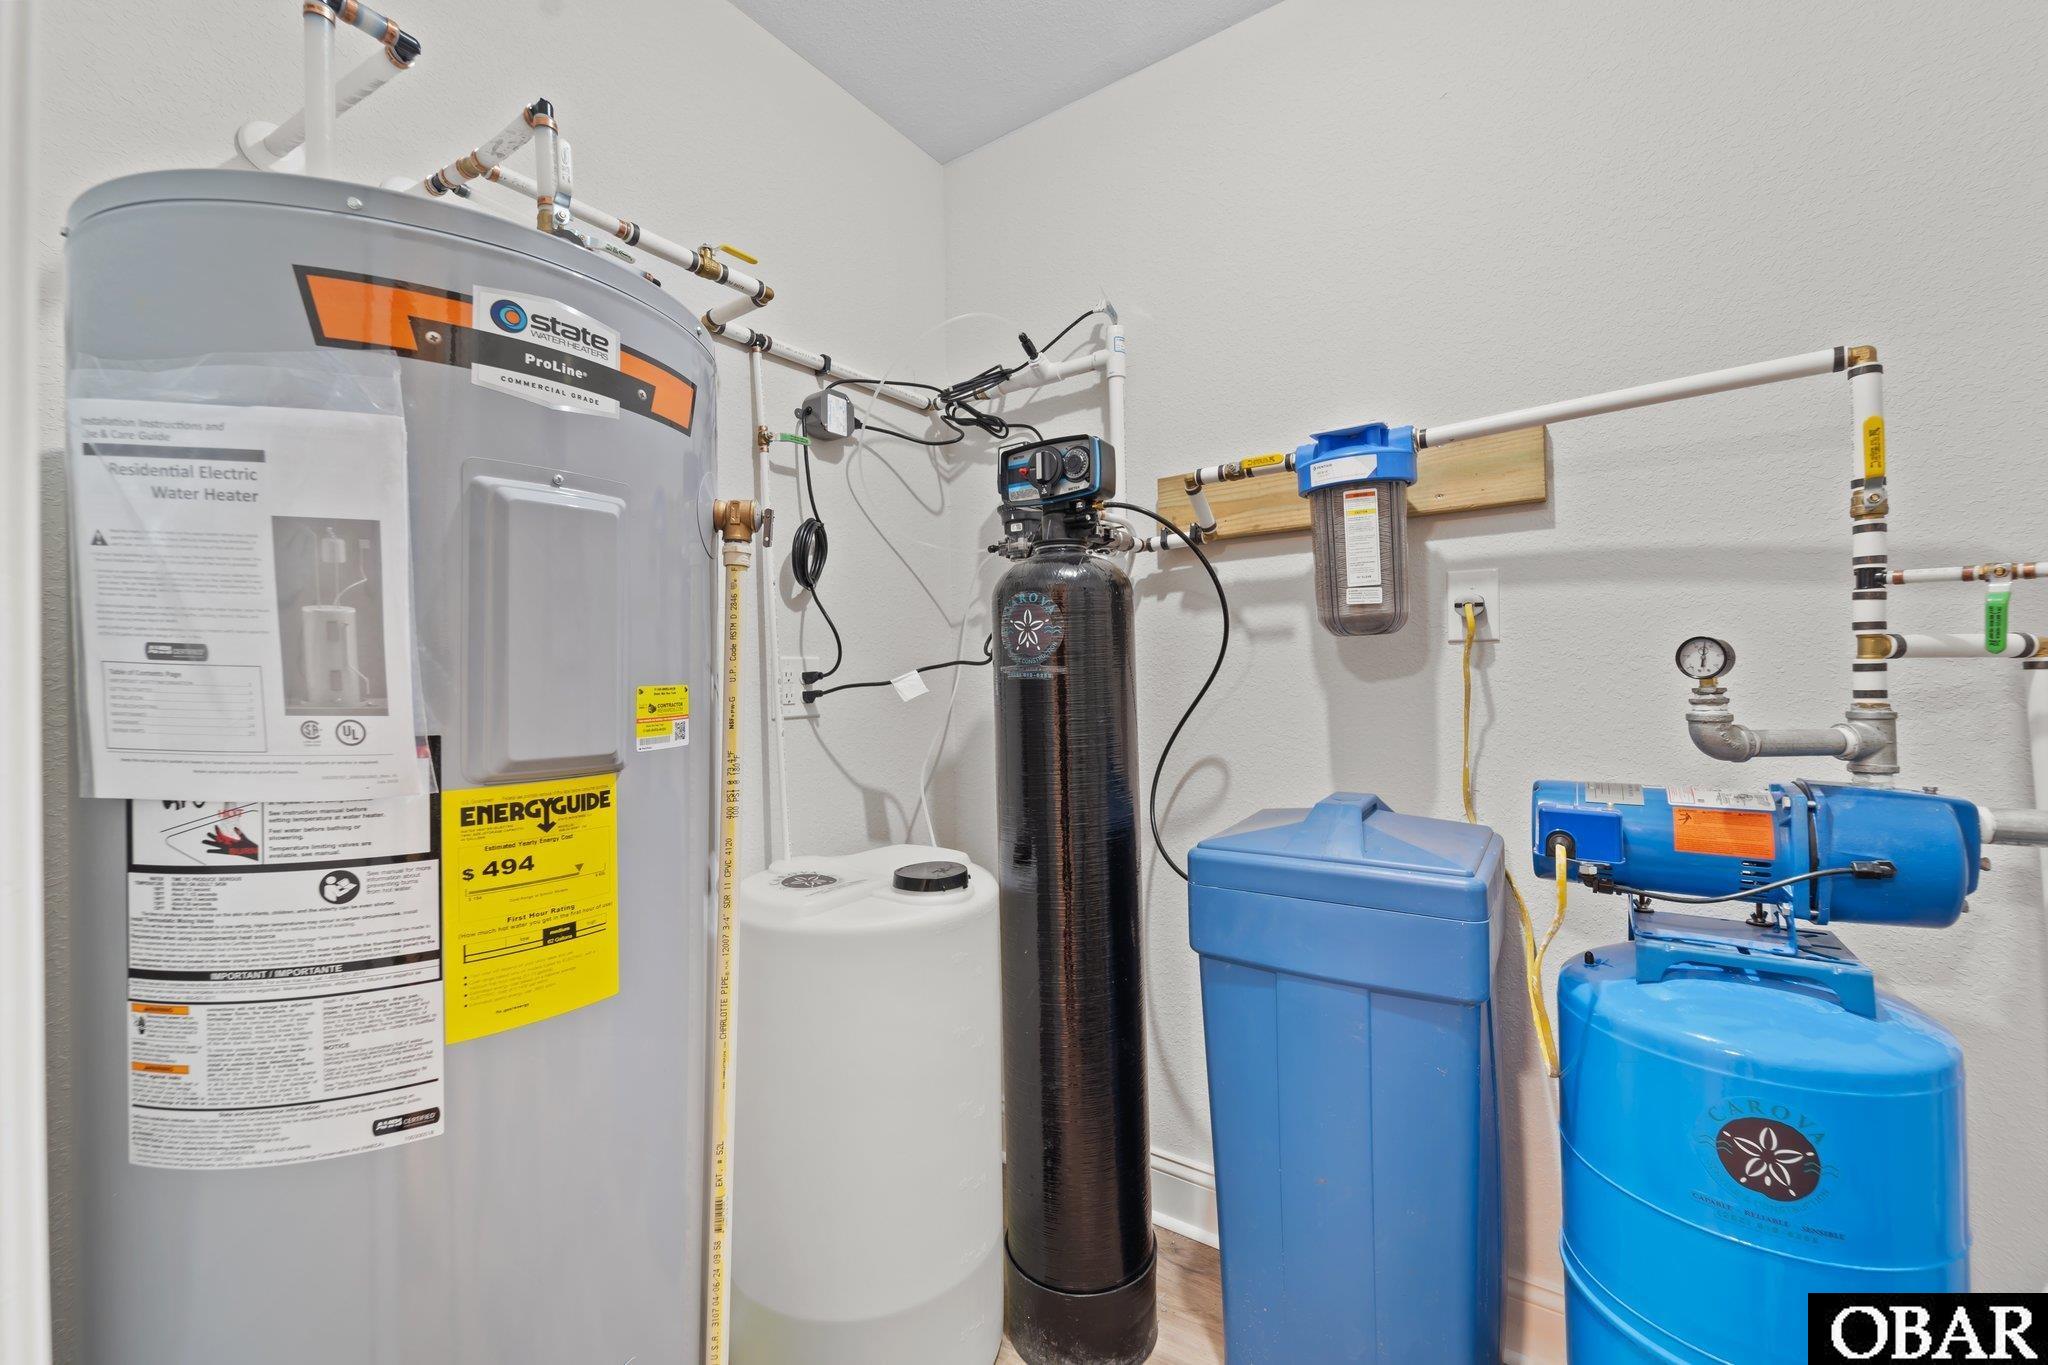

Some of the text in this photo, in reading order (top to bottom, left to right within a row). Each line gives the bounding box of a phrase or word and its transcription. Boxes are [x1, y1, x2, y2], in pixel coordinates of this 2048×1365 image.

[530, 314, 609, 353] state
[530, 330, 609, 361] WATER HEATERS
[500, 375, 600, 406] COMMERCIAL GRADE
[138, 418, 202, 430] Instructions
[205, 422, 225, 431] and
[111, 429, 135, 440] Care
[138, 431, 171, 441] Guide
[108, 462, 258, 481] Residential Electric
[151, 485, 259, 502] Water Heater
[730, 593, 738, 611] 2846
[729, 623, 738, 640] ASTM
[729, 643, 738, 662] Code
[460, 789, 611, 829] ENERGYGUIDE
[485, 842, 516, 852] Estimated
[518, 839, 538, 848] Yearly
[539, 836, 559, 845] Energy
[724, 838, 733, 856] 4120
[482, 855, 535, 877] 494
[724, 860, 733, 878] CPVC
[724, 882, 732, 890] 11
[723, 895, 732, 909] SDR
[506, 904, 575, 923] First Hour Rating
[477, 927, 497, 936] much
[510, 921, 527, 930] water
[529, 919, 541, 928] you
[210, 969, 268, 981] IMPORTANT
[274, 964, 344, 978] IMPORTANTE
[719, 976, 729, 994] PIPE
[719, 999, 729, 1040] CHARLOTTE
[323, 1041, 351, 1050] NOTICE
[1707, 1099, 1826, 1144] CAROVA
[1743, 1208, 1790, 1228] RELIABLE
[1800, 1224, 1847, 1241] SENSIBLE
